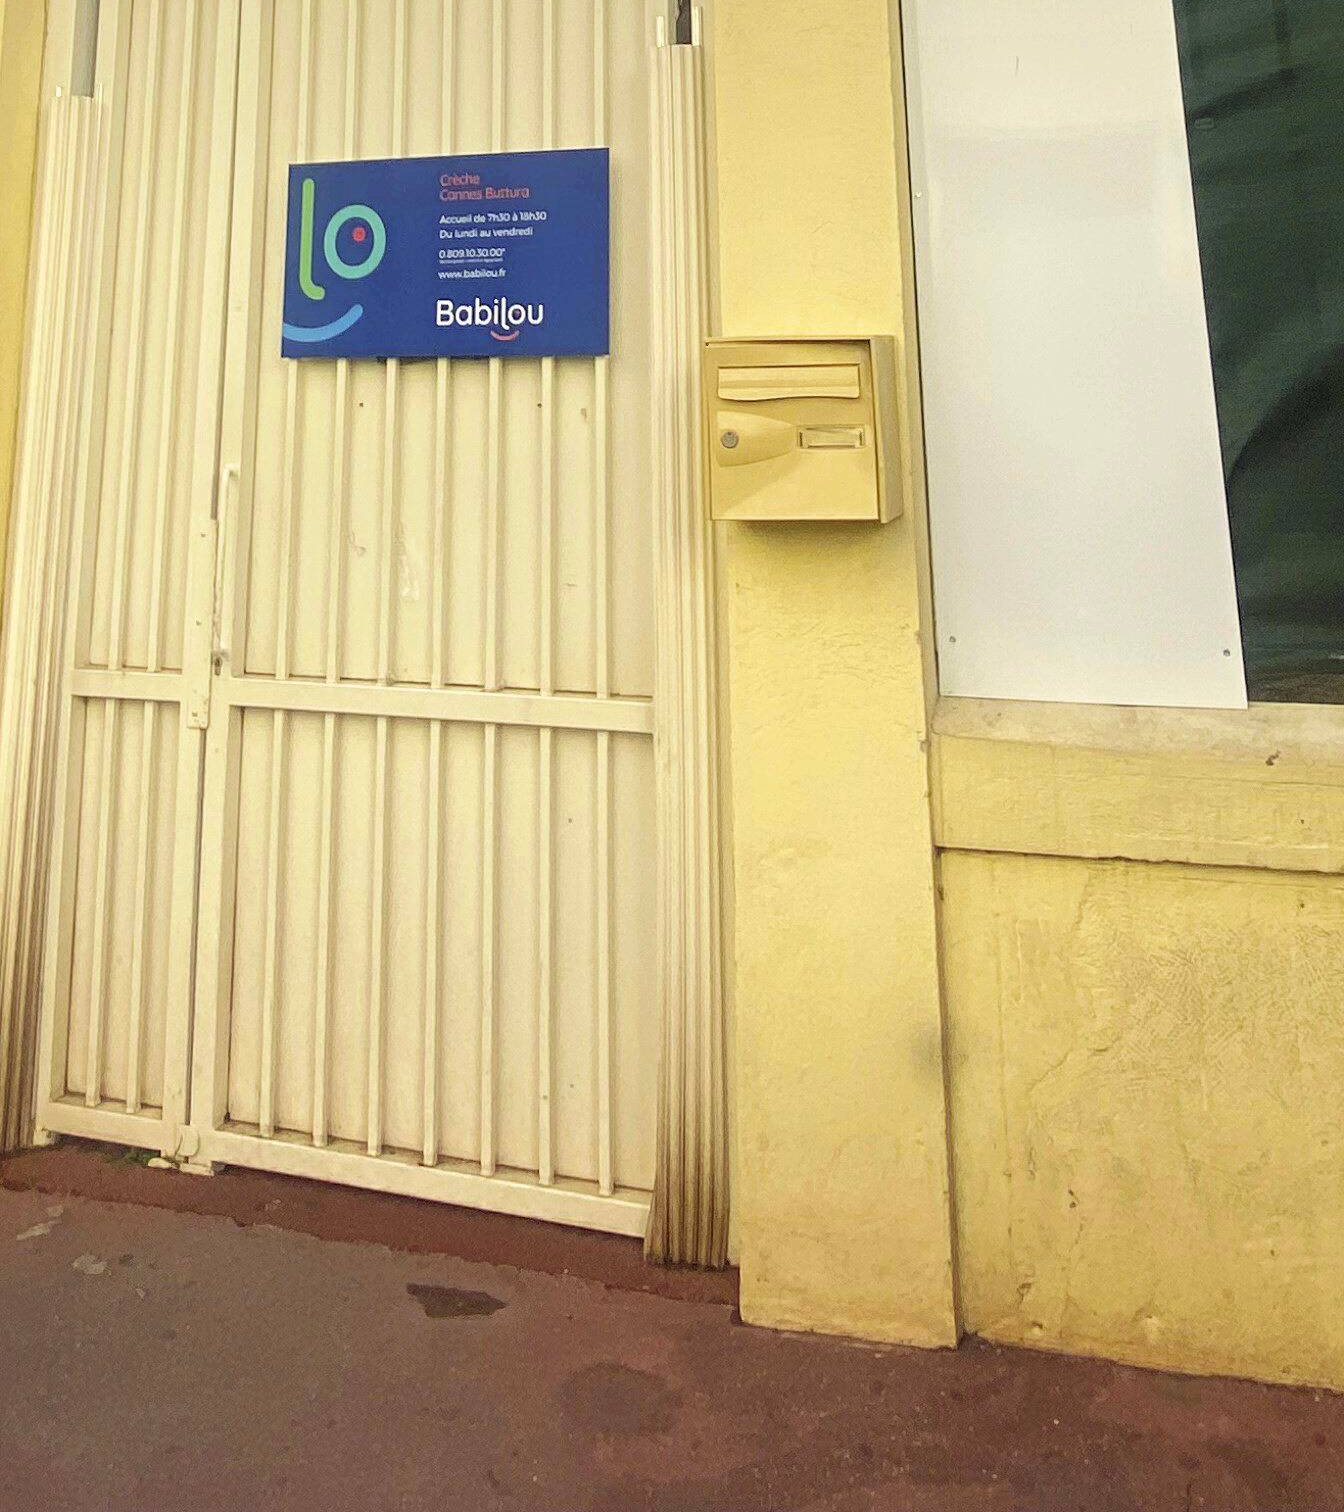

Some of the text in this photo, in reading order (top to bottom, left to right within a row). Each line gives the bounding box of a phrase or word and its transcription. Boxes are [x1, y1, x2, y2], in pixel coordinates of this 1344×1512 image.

[439, 214, 472, 224] Accueil
[474, 213, 485, 223] de
[487, 212, 511, 223] 7h30
[439, 229, 453, 239] Du
[455, 228, 478, 238] lundi
[493, 226, 533, 237] vendredi
[435, 297, 545, 330] Babilou
